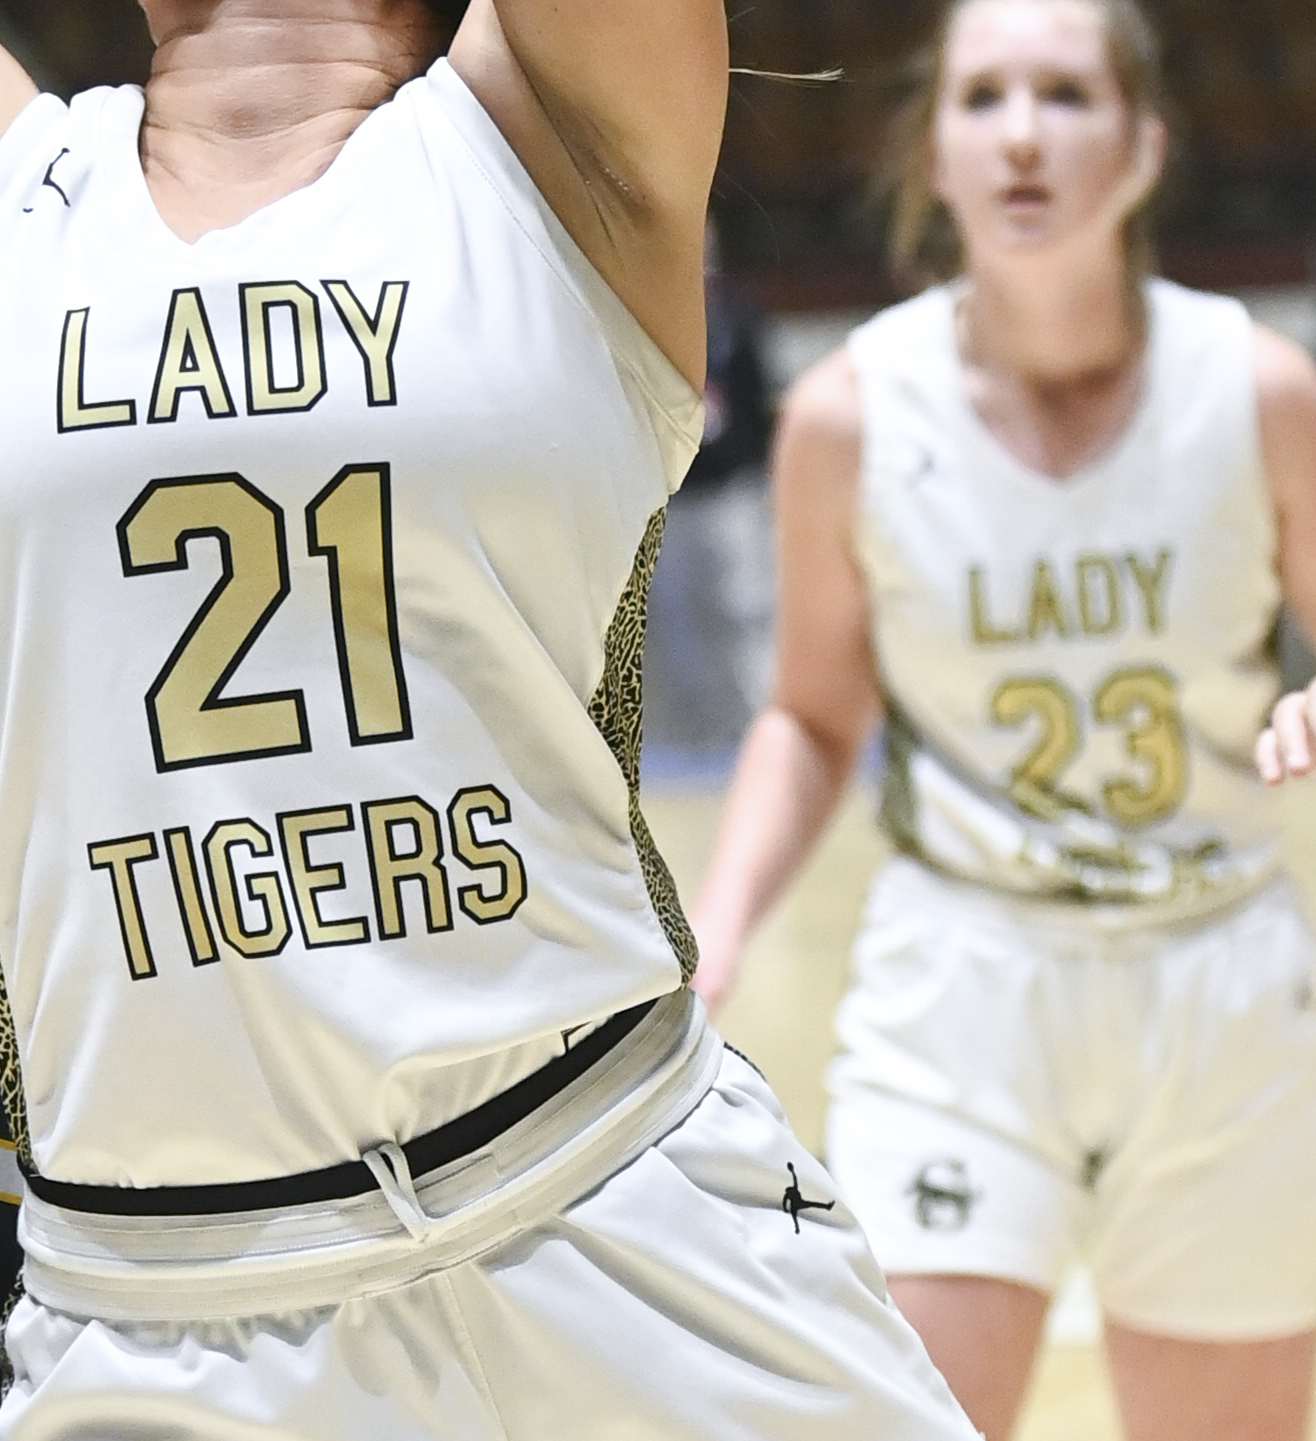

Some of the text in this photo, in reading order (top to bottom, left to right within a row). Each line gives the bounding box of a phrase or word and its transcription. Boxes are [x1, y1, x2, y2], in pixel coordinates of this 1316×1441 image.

[57, 279, 410, 433] LADY
[115, 461, 414, 774] 21
[966, 548, 1173, 644] LADY
[990, 667, 1182, 827] 23
[87, 784, 528, 981] TIGERS
